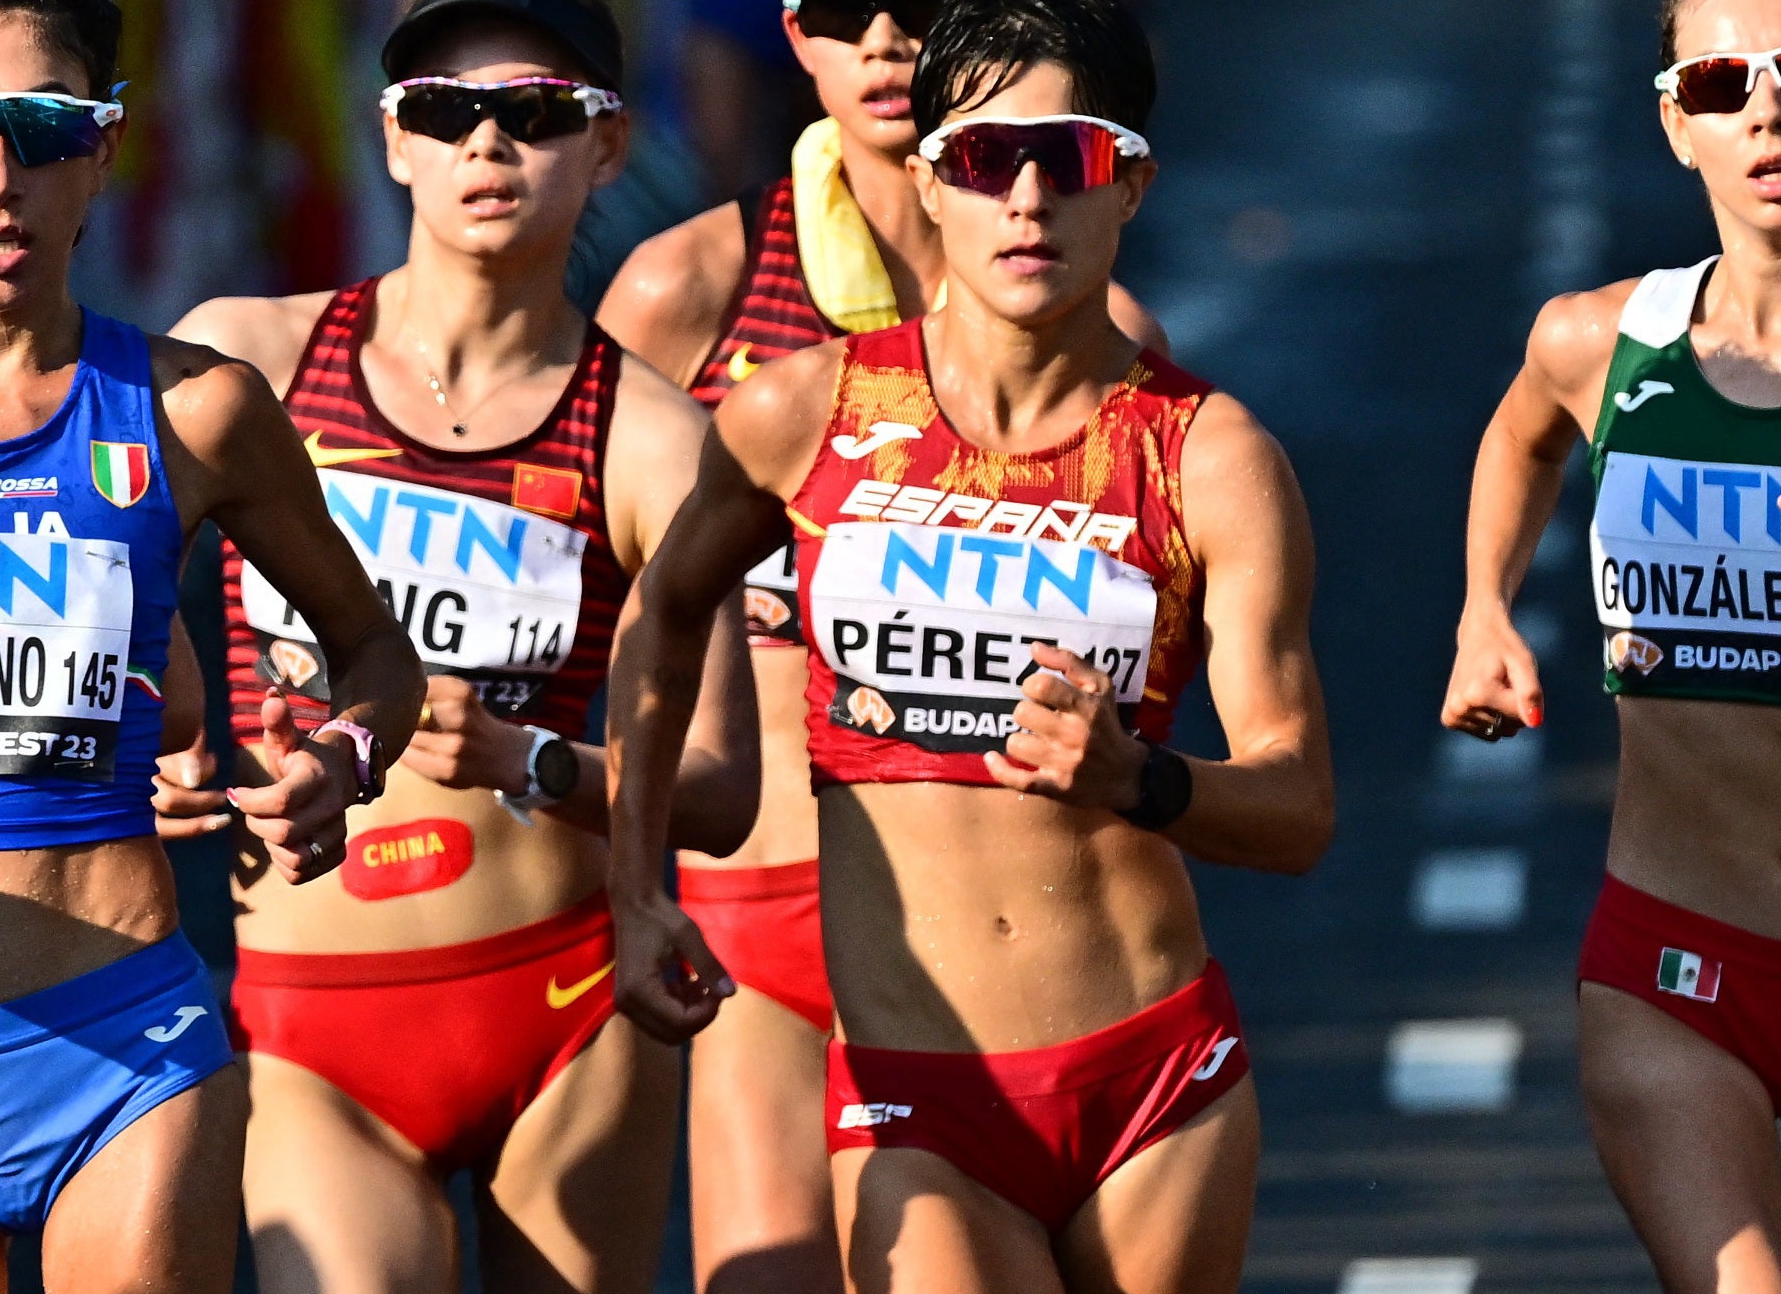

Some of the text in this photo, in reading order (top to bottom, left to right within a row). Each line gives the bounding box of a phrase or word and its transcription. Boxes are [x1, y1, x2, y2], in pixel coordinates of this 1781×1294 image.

[326, 479, 530, 585] NTN
[838, 478, 1138, 552] ESPAÑA
[880, 529, 1096, 616] NTN
[507, 615, 565, 669] 114
[63, 649, 119, 710] 145
[61, 734, 97, 762] 23
[904, 707, 1024, 739] BUDAP
[362, 831, 446, 869] CHINA
